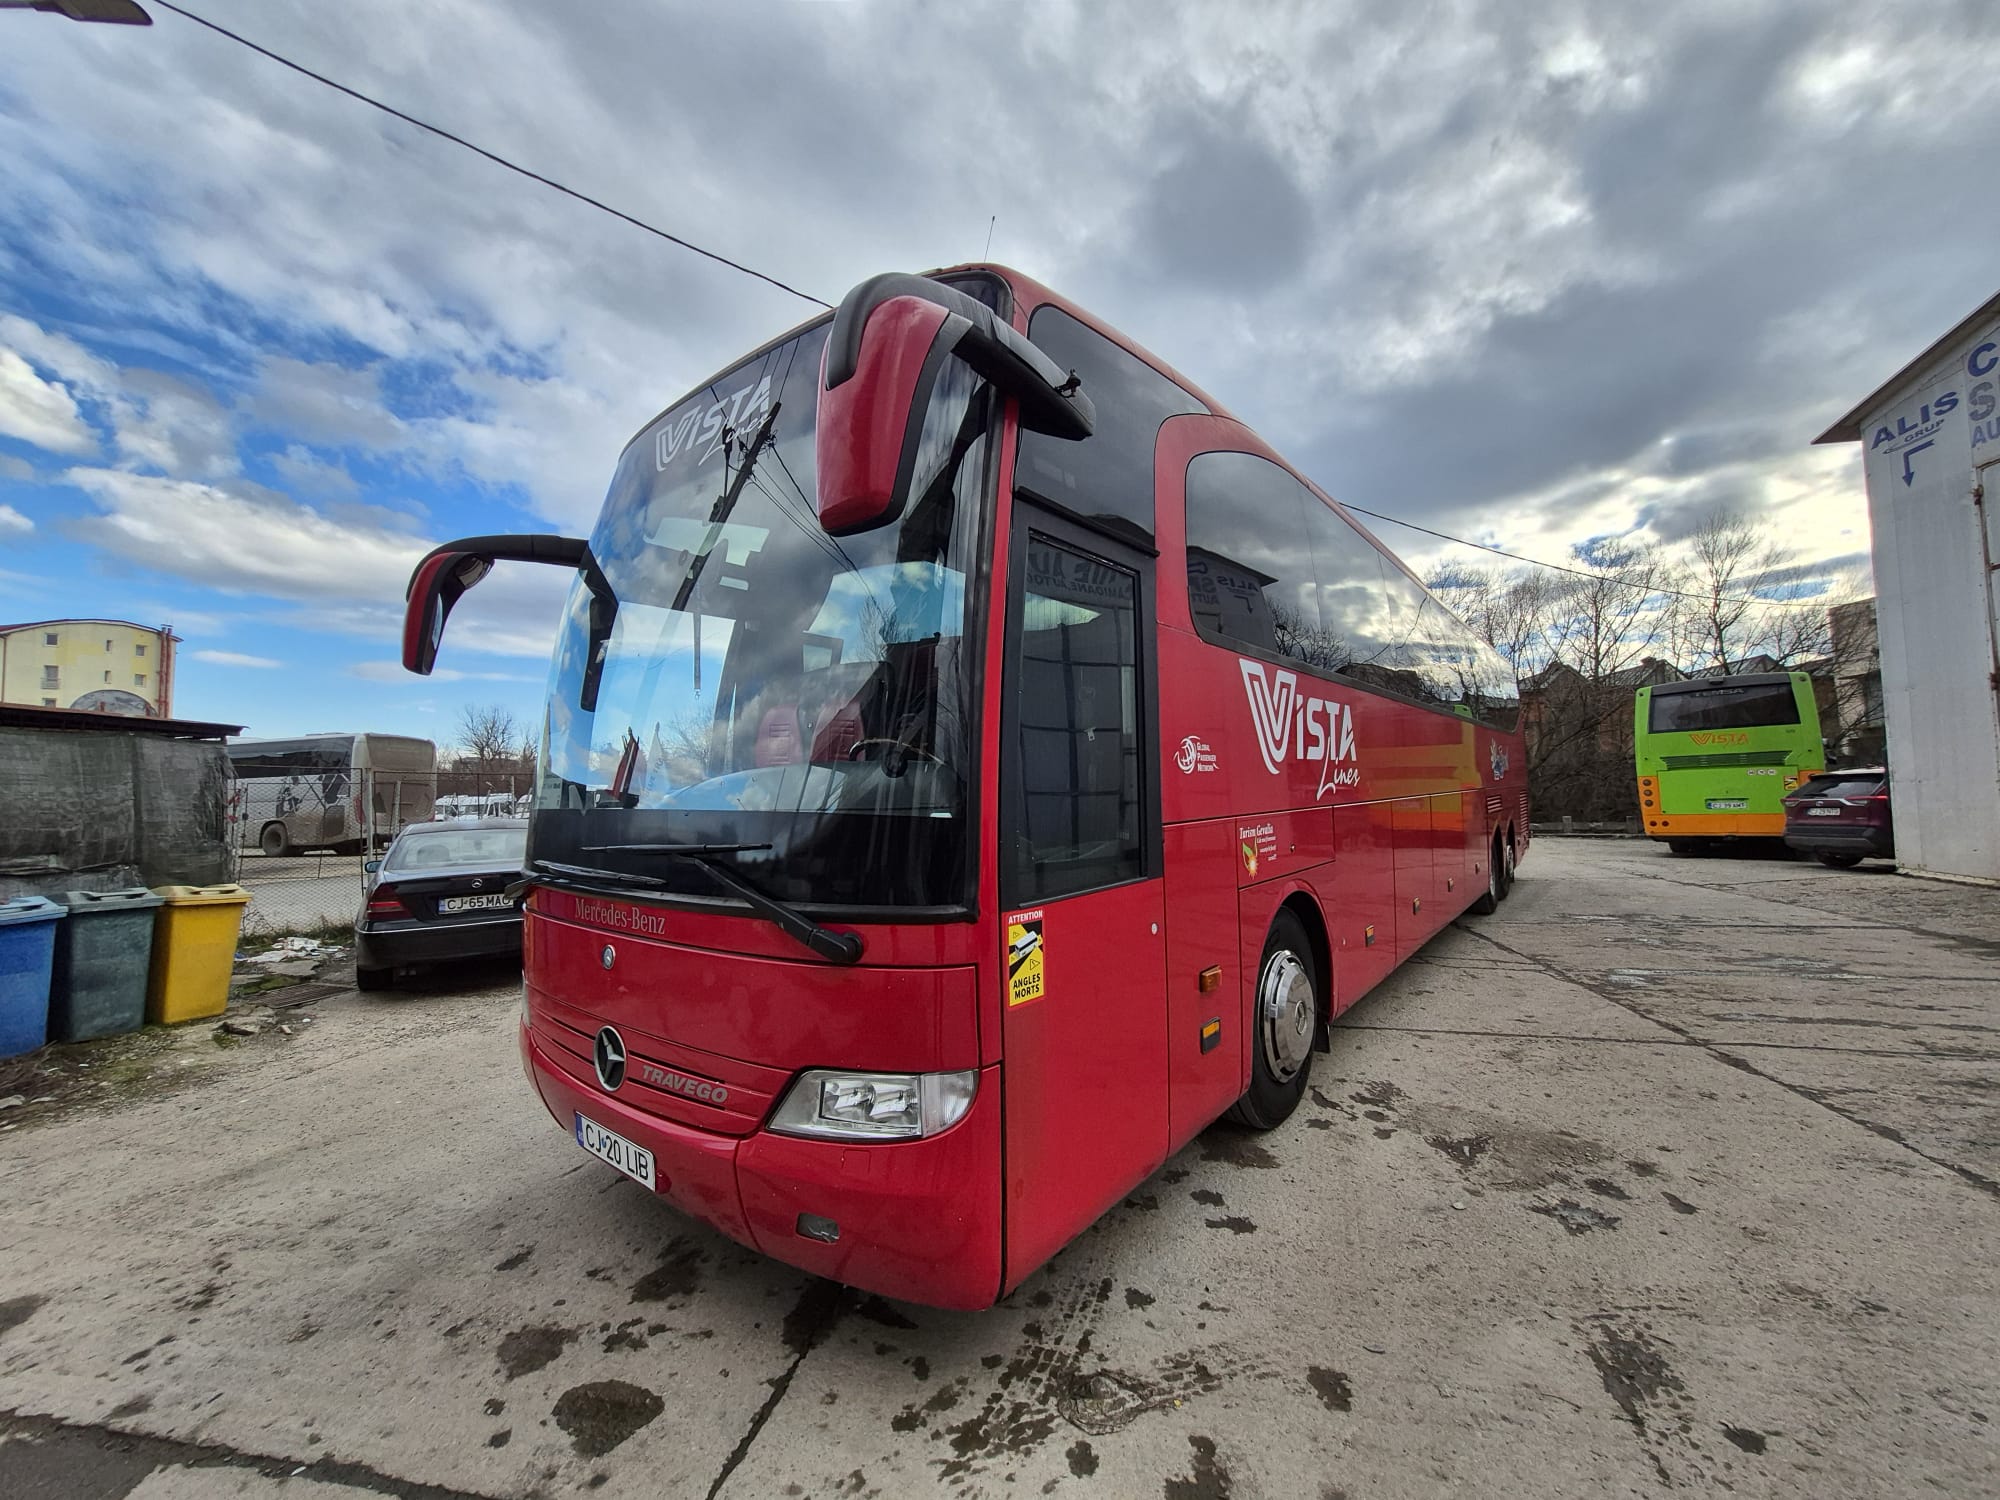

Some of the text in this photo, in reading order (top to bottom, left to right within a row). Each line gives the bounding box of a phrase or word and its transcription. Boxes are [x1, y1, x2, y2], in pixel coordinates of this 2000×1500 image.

[1871, 391, 1959, 450] ALIS
[1316, 736, 1361, 801] Lines
[447, 900, 464, 910] CJ
[469, 897, 485, 908] 65
[575, 898, 665, 935] Mercedes-Benz
[1008, 909, 1043, 924] ATTENTION
[1013, 973, 1041, 990] ANGLES
[1014, 983, 1040, 1000] MORTS
[642, 1064, 728, 1103] TRAVEGO
[585, 1123, 649, 1181] CJ 20 LIB
